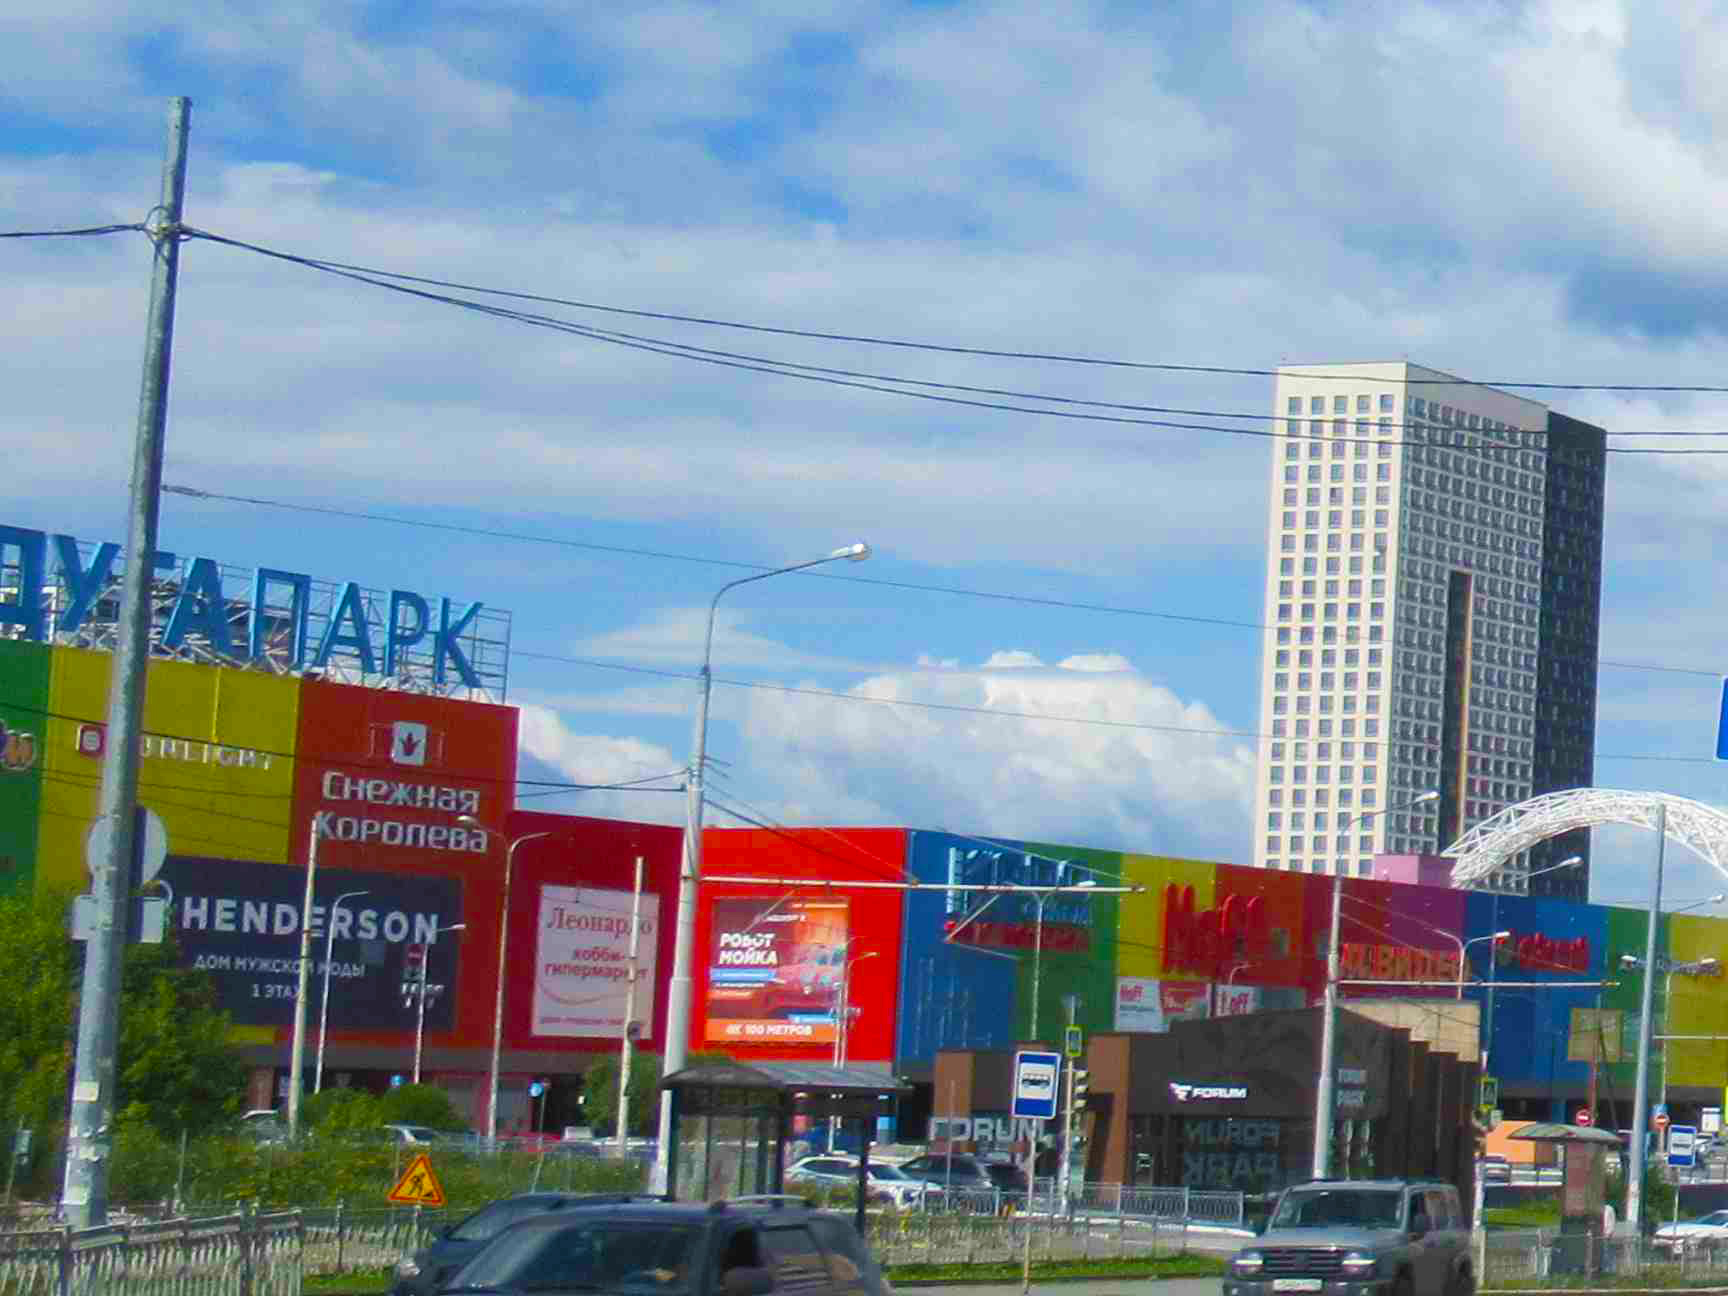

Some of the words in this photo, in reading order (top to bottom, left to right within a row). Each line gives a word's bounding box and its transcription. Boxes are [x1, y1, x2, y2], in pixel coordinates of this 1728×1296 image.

[139, 736, 273, 771] UNLIGHT
[322, 769, 481, 814] Снежная
[314, 809, 488, 853] Королева
[181, 895, 439, 945] HENDERSON
[546, 906, 652, 940] Леонаро
[719, 931, 777, 948] РОБОТ
[192, 953, 232, 971] ДОМ
[718, 947, 778, 965] МОЙКА
[251, 983, 260, 998] 1
[765, 1023, 813, 1037] МЕТРОВ
[1191, 1087, 1248, 1099] FORUM
[929, 1116, 1045, 1142] FORUM
